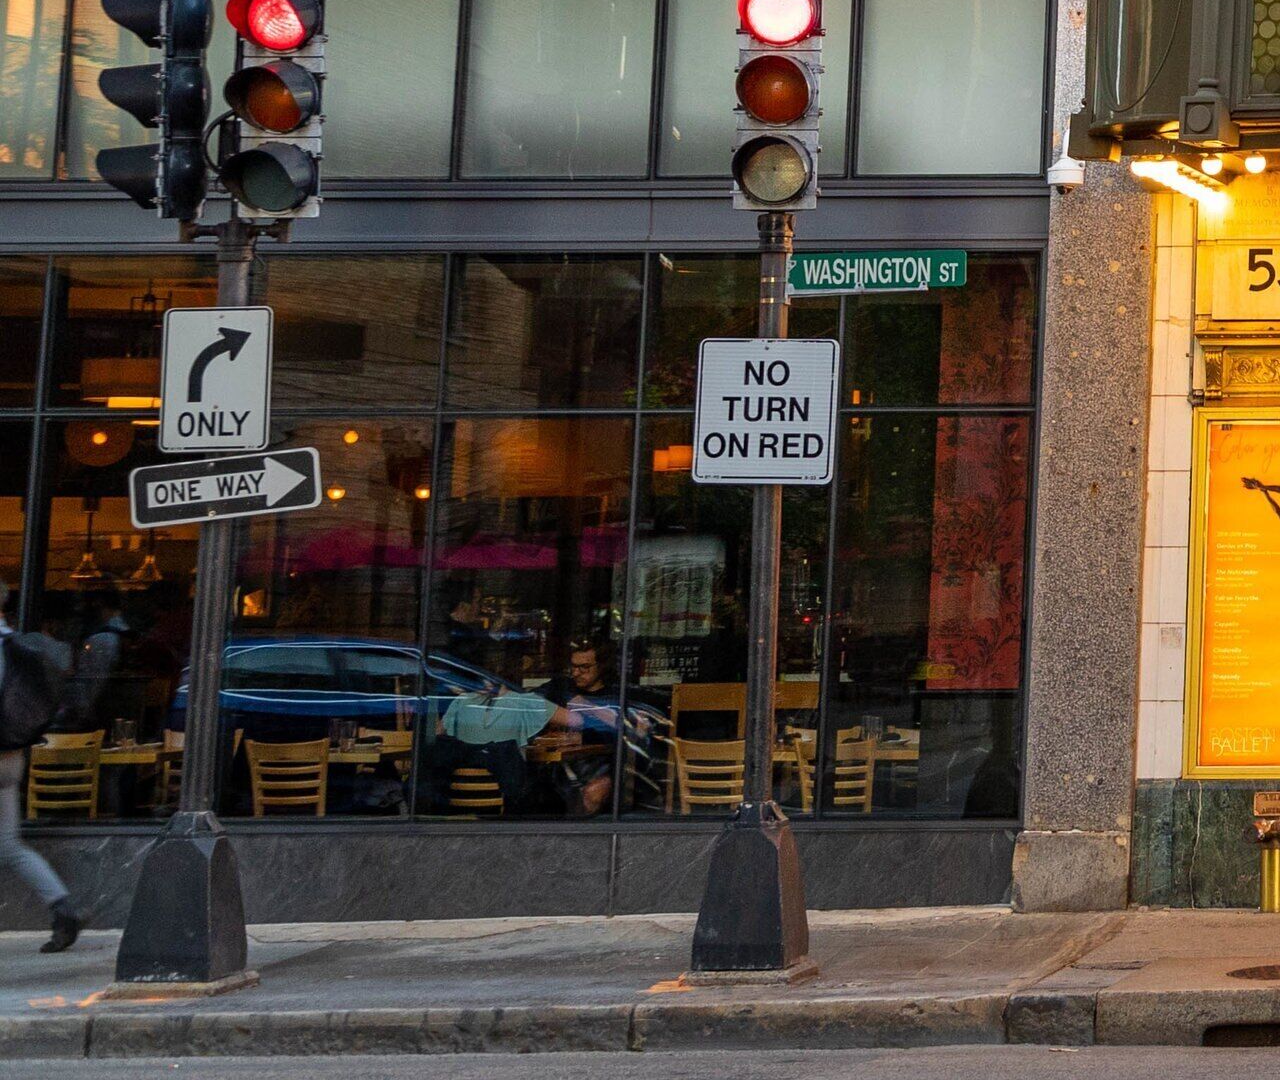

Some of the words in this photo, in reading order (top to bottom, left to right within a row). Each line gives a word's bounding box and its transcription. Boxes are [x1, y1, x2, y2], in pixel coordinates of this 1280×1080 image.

[803, 257, 931, 285] WASHINGTON
[939, 262, 959, 282] ST
[744, 360, 790, 386] NO
[722, 396, 810, 422] TURN
[178, 411, 251, 438] ONLY
[703, 432, 749, 458] ON
[758, 433, 824, 458] RED
[154, 479, 202, 505] ONE
[216, 472, 265, 498] WAY
